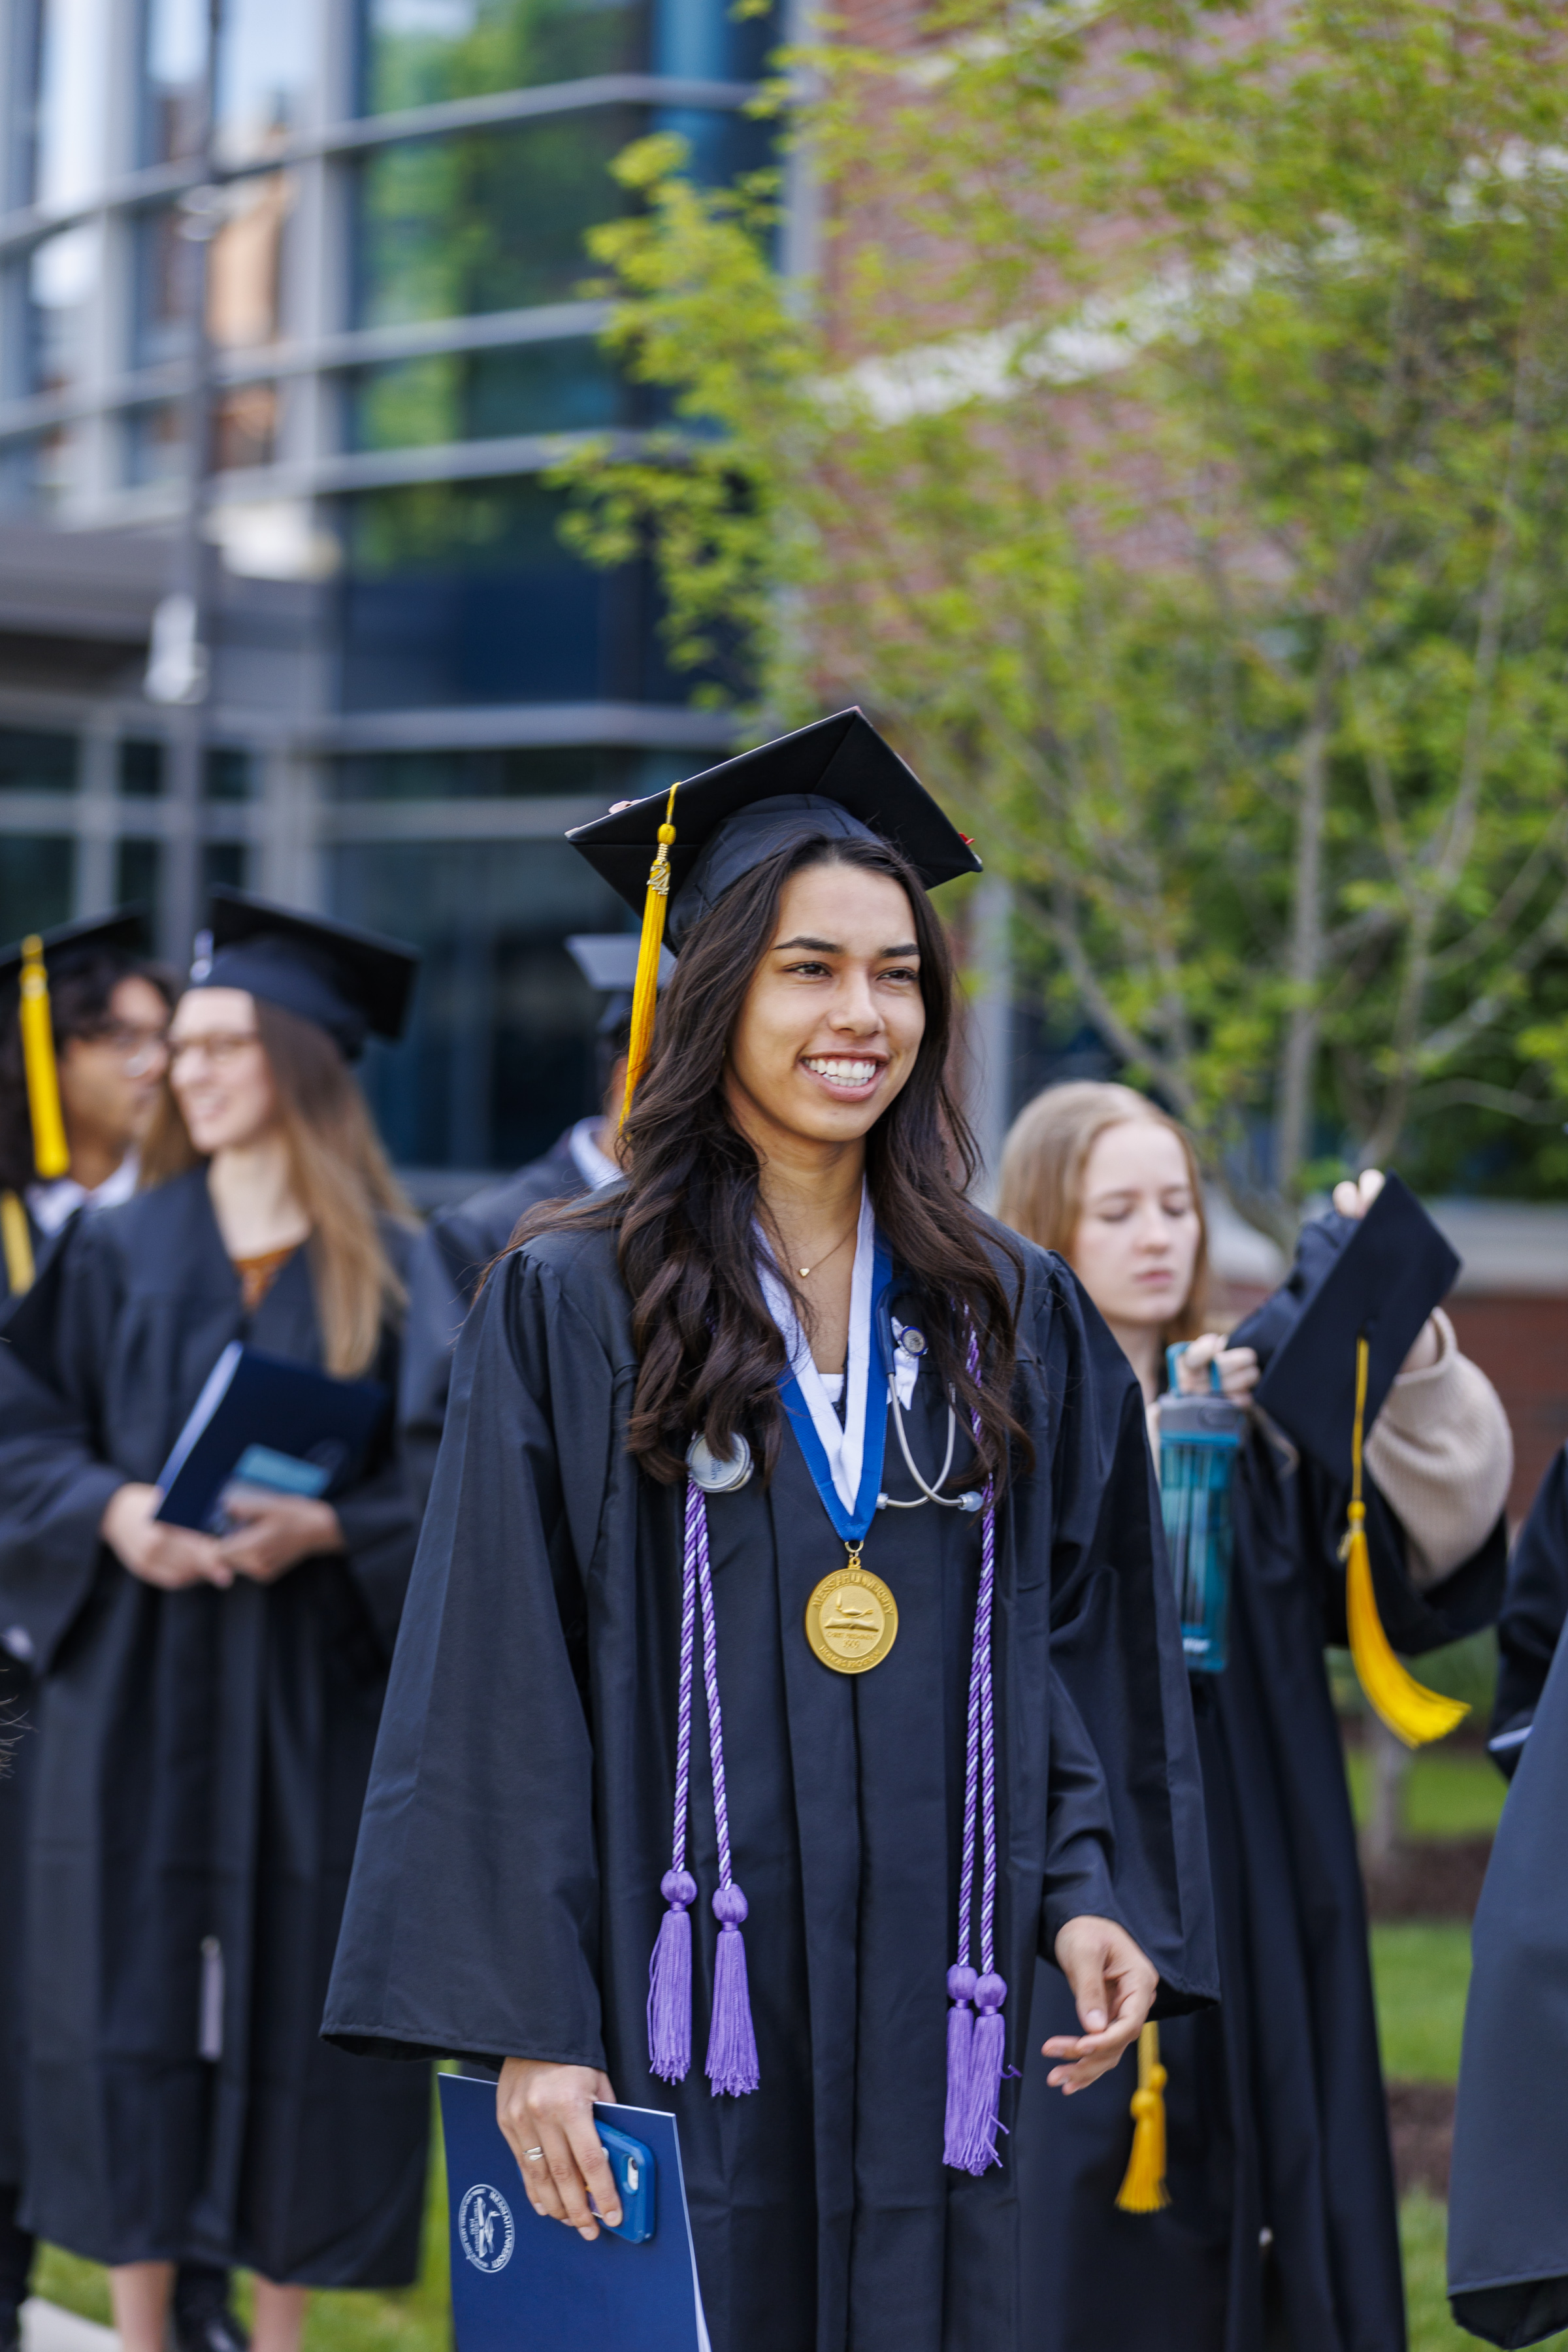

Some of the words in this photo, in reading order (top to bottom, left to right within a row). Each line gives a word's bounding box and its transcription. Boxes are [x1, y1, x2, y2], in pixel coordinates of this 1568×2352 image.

[646, 865, 670, 894] 24
[812, 1573, 850, 1609] MESSIAH
[851, 1573, 894, 1614] UNIVERSITY
